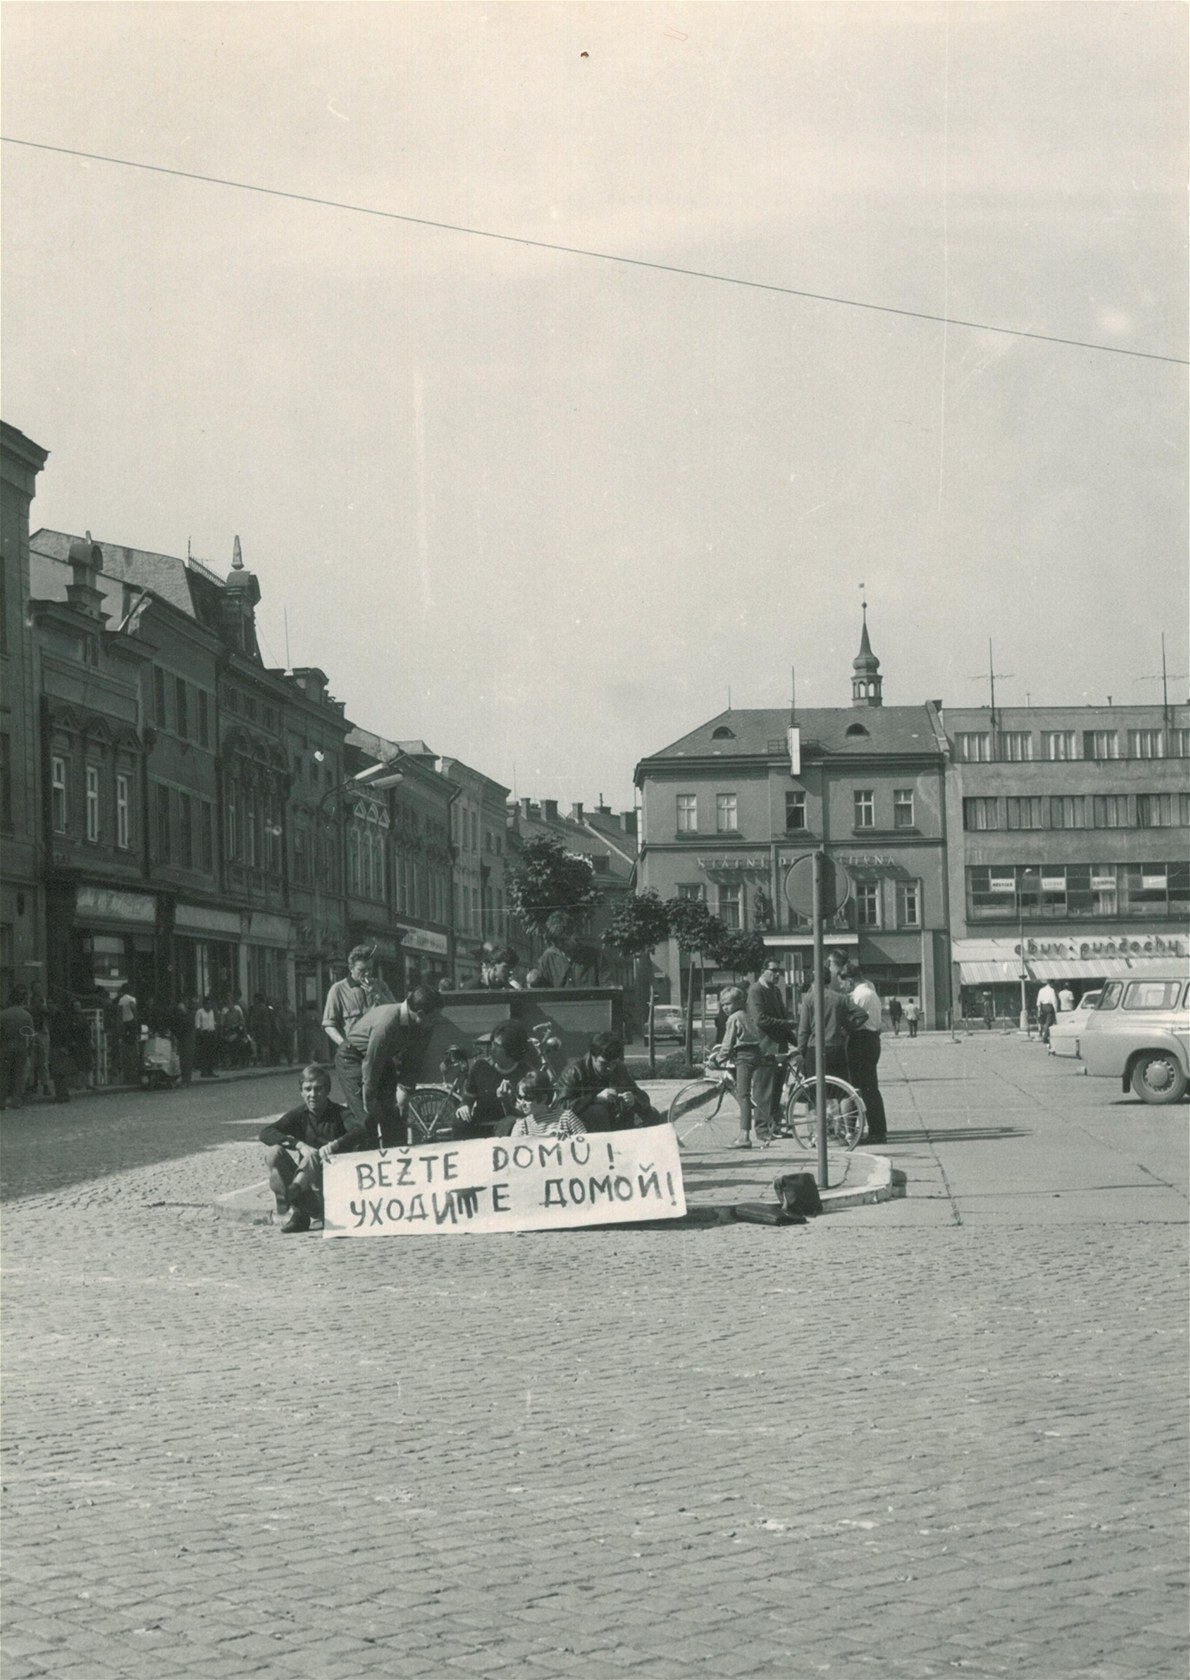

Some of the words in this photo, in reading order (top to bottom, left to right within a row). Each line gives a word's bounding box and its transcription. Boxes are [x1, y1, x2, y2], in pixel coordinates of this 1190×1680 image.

[1080, 936, 1178, 959] punčochy
[355, 1148, 460, 1191] BĚŽTE
[539, 1162, 678, 1208] ДОМОЙ!
